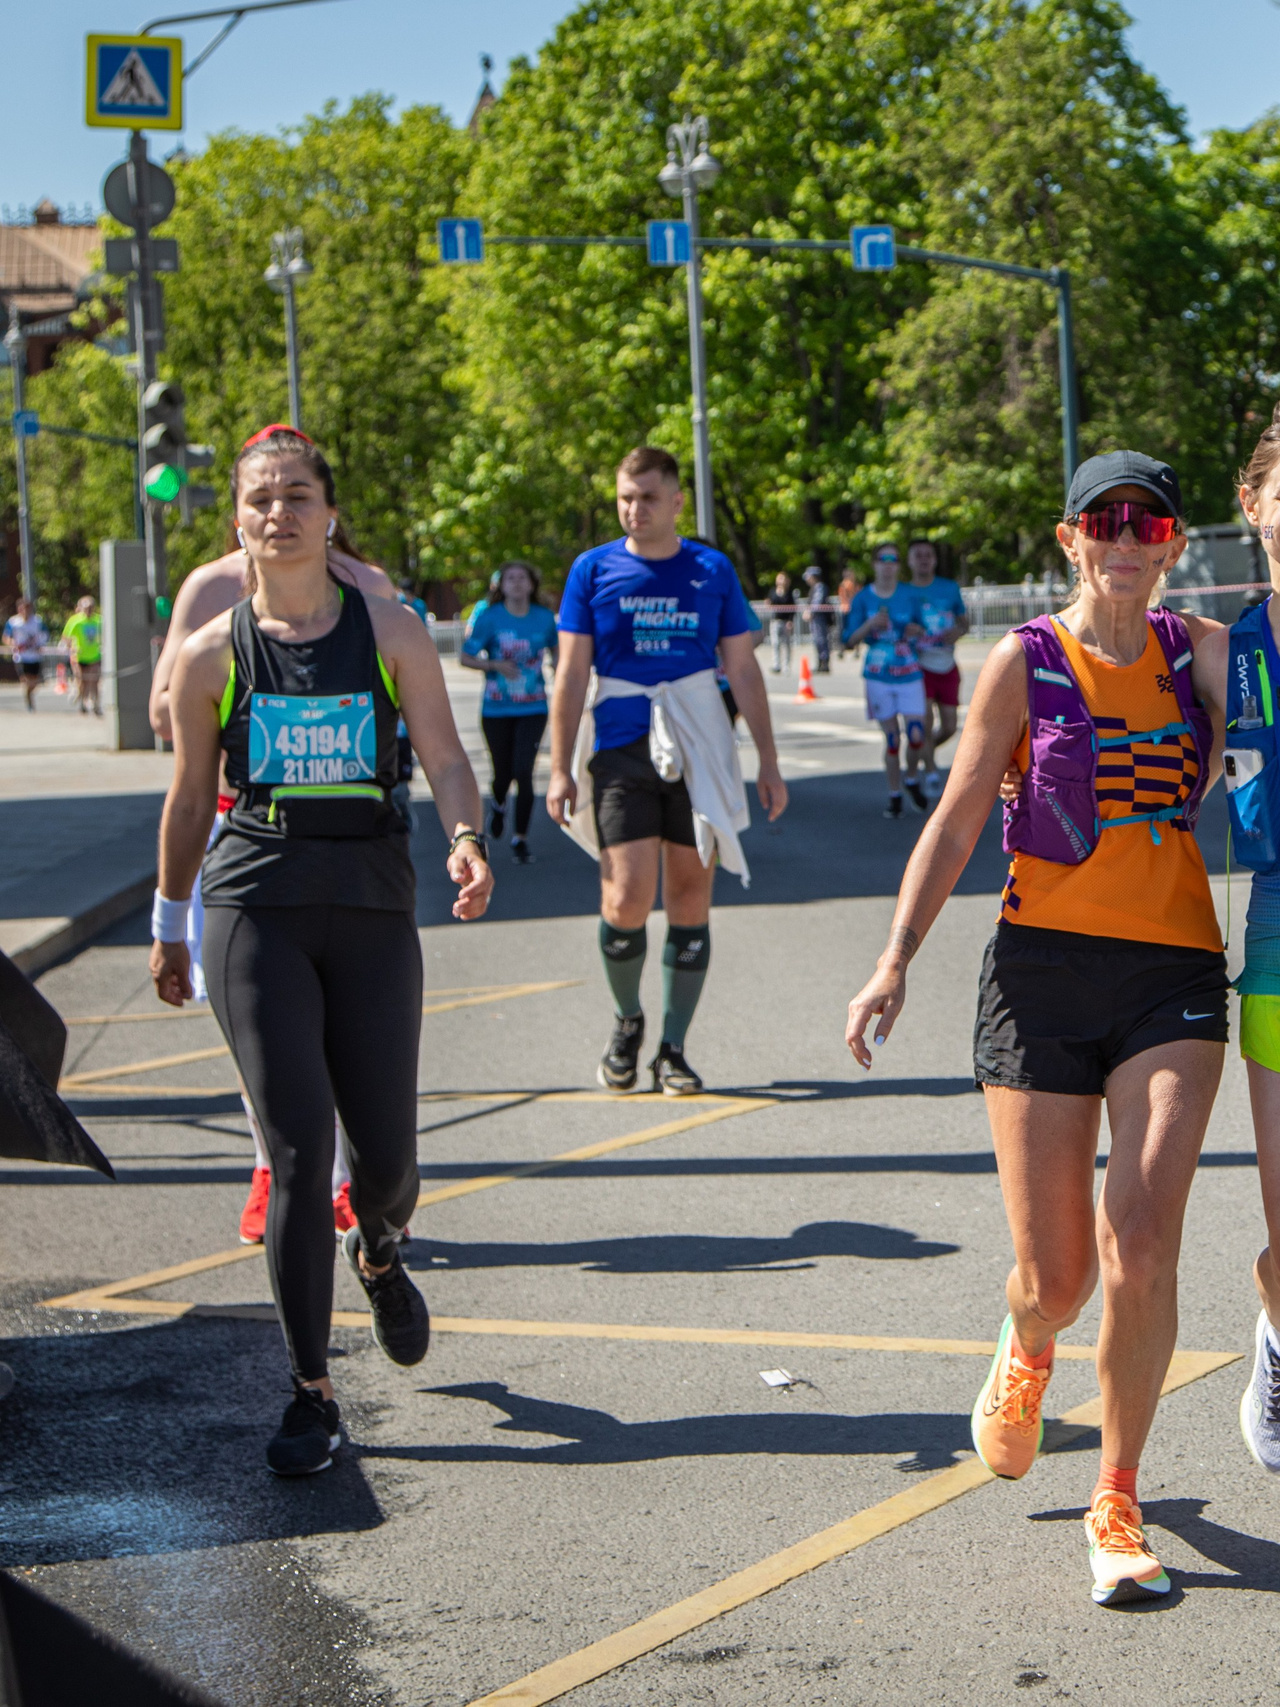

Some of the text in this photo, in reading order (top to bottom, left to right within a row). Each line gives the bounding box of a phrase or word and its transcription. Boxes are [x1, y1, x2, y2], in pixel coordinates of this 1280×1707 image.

[619, 596, 679, 613] WHITE
[633, 611, 699, 629] NIGHTS
[634, 639, 670, 653] 2019
[275, 724, 351, 756] 43194
